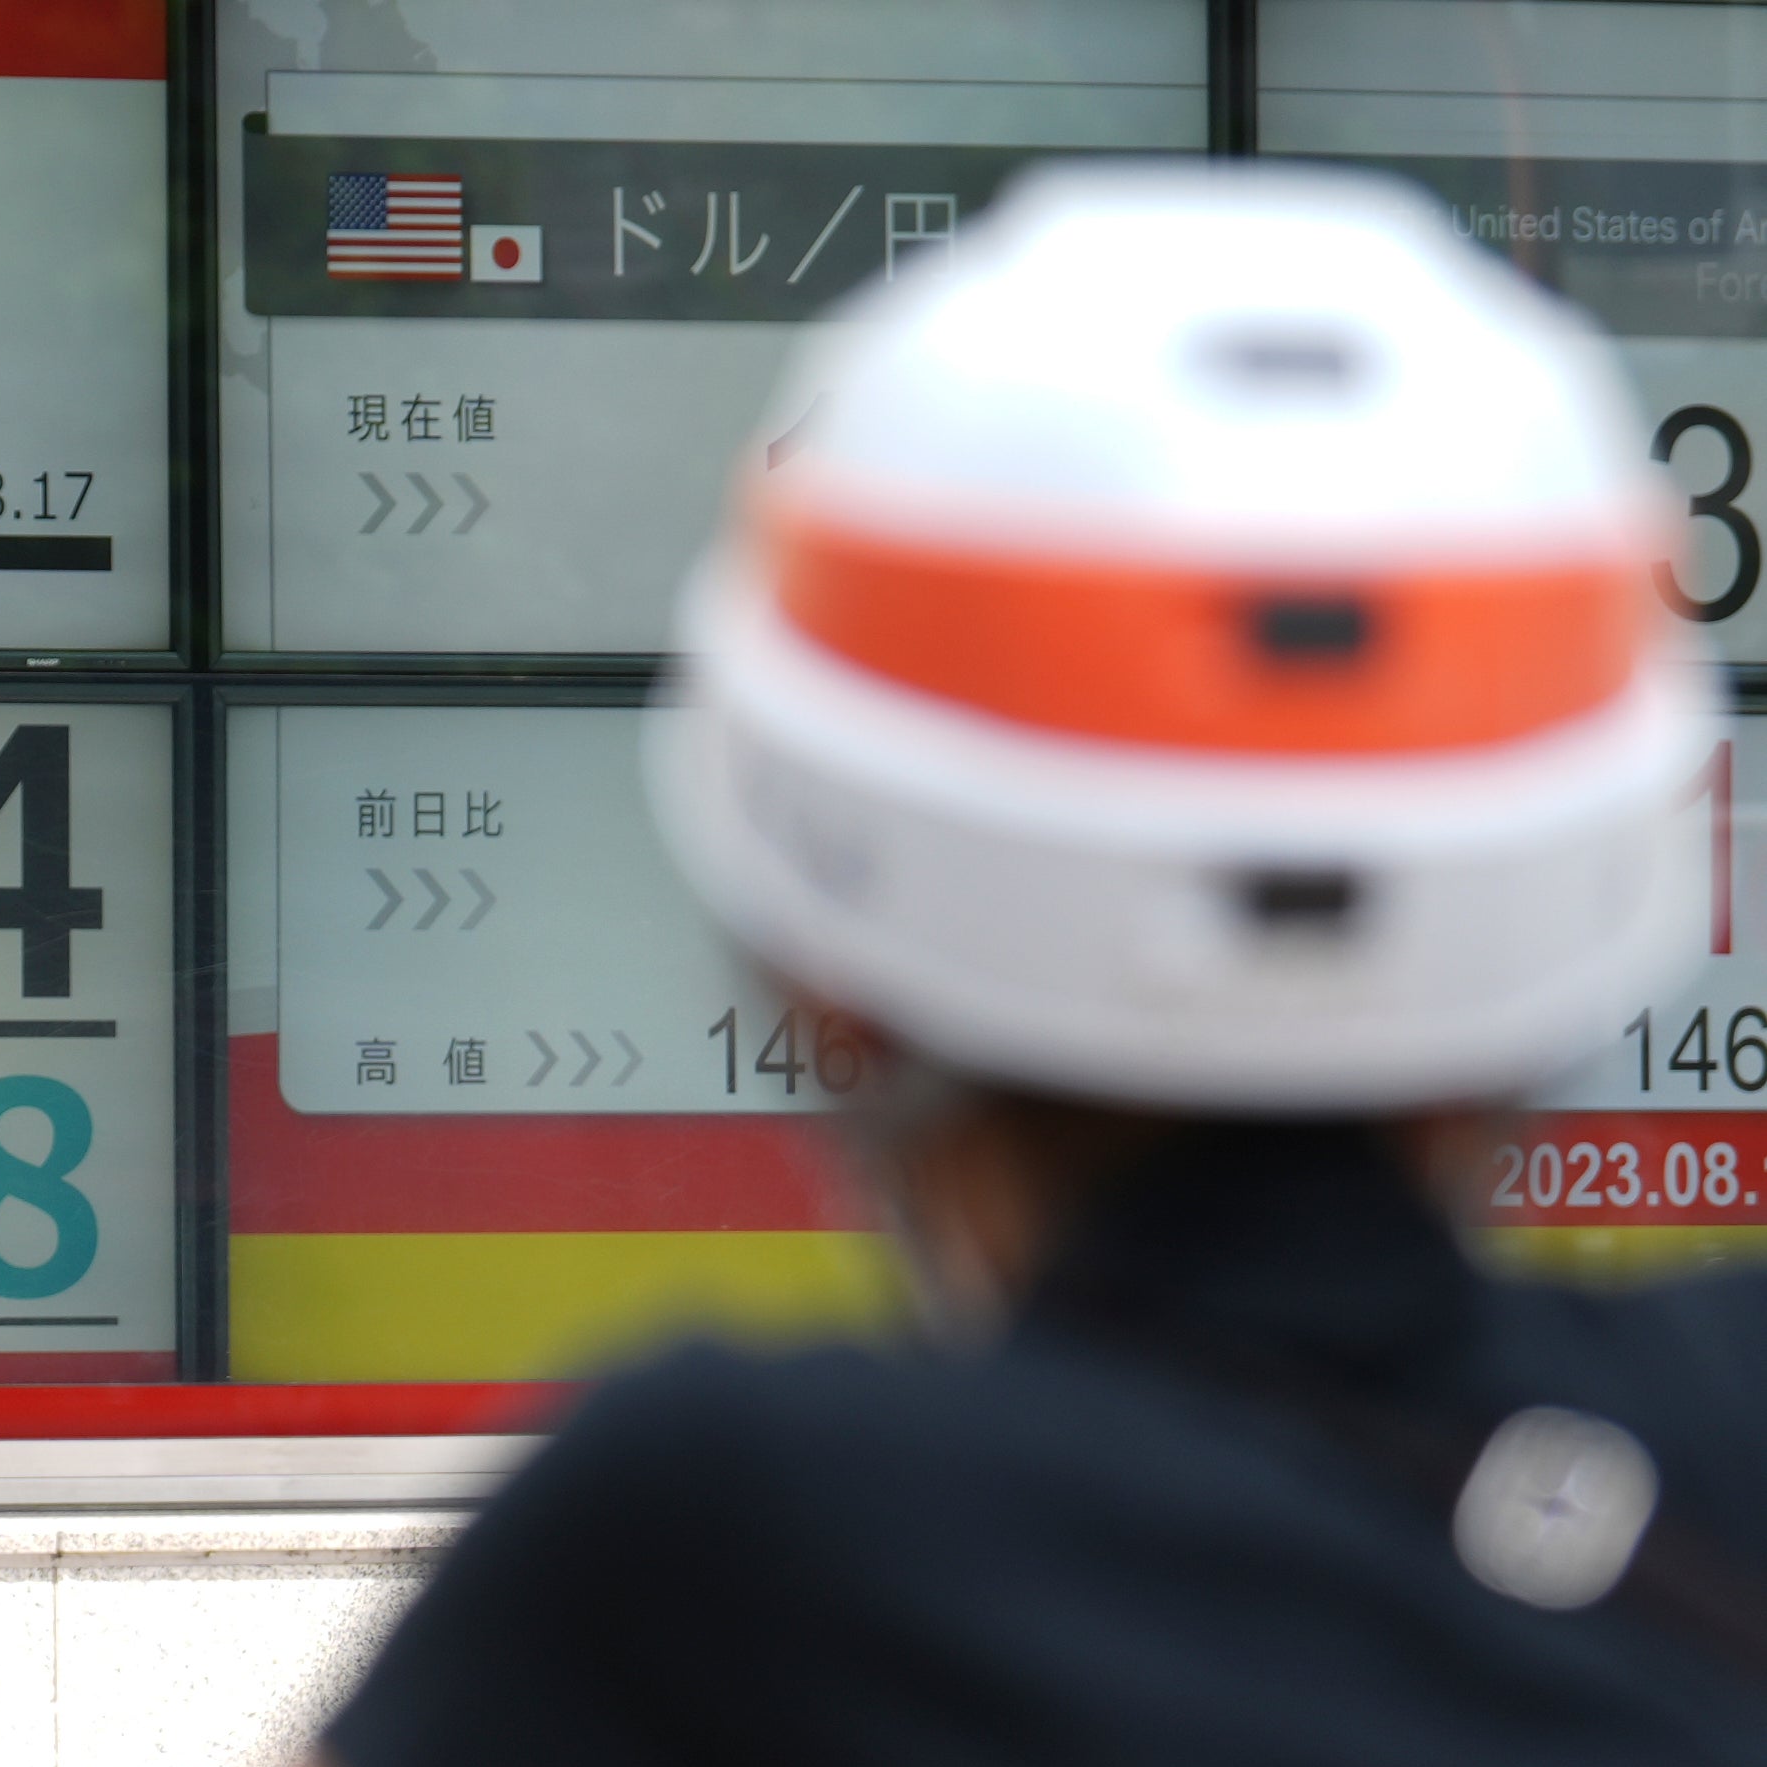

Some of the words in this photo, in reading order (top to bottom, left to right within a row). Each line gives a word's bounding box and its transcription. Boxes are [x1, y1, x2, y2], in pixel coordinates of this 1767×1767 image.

[1452, 203, 1562, 240] United
[1572, 205, 1677, 243] States
[1688, 208, 1724, 244] of
[1735, 209, 1767, 243] A
[1695, 261, 1767, 301] For
[347, 394, 496, 442] 現在値
[355, 788, 506, 839] 前日比
[1489, 1140, 1767, 1208] 2023.08.
